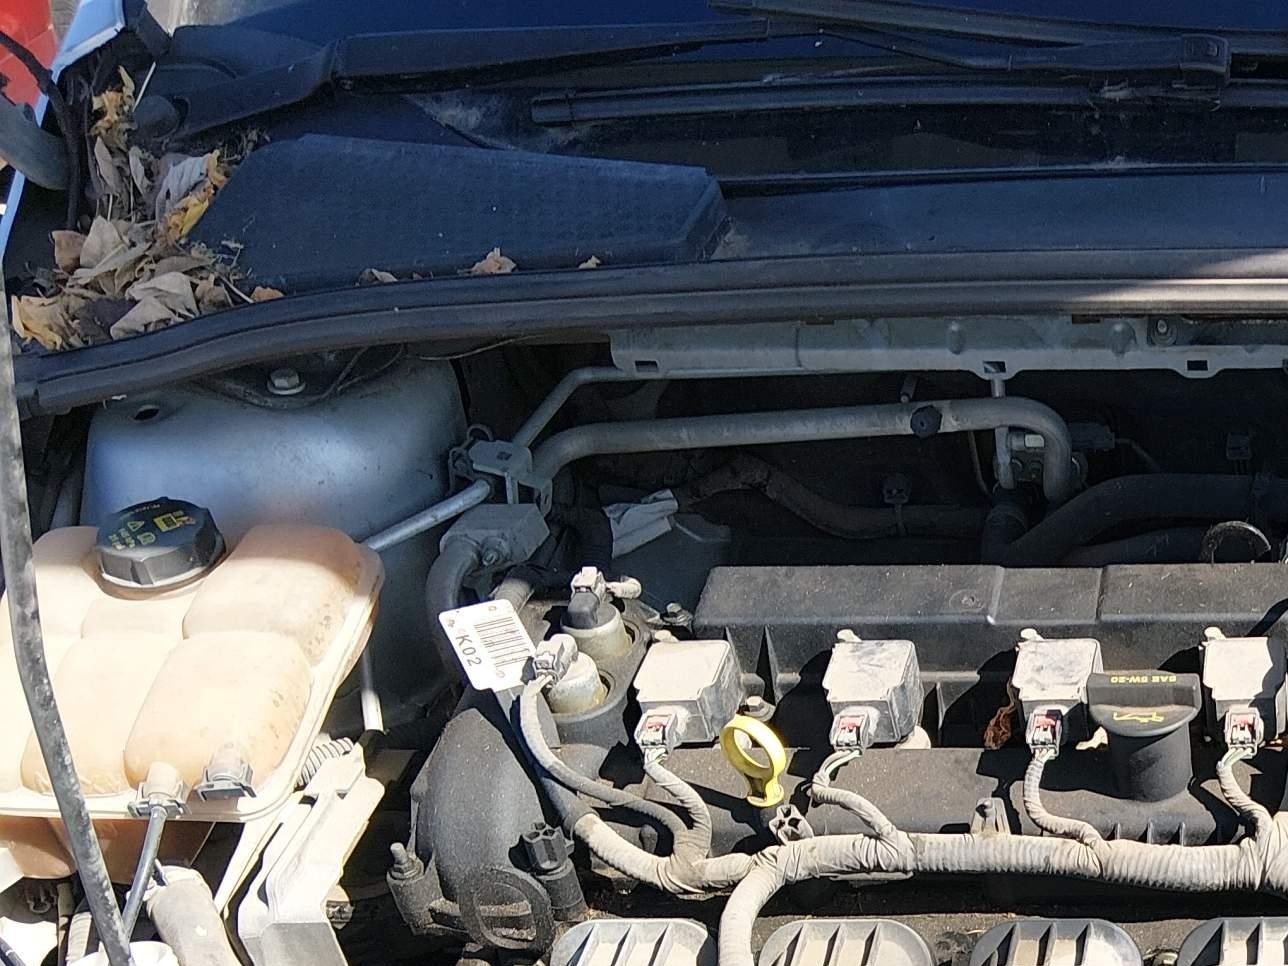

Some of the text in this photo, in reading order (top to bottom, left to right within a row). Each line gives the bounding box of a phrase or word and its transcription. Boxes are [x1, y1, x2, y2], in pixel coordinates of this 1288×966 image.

[455, 634, 483, 667] K02
[1110, 675, 1177, 684] SAE 5W-20
